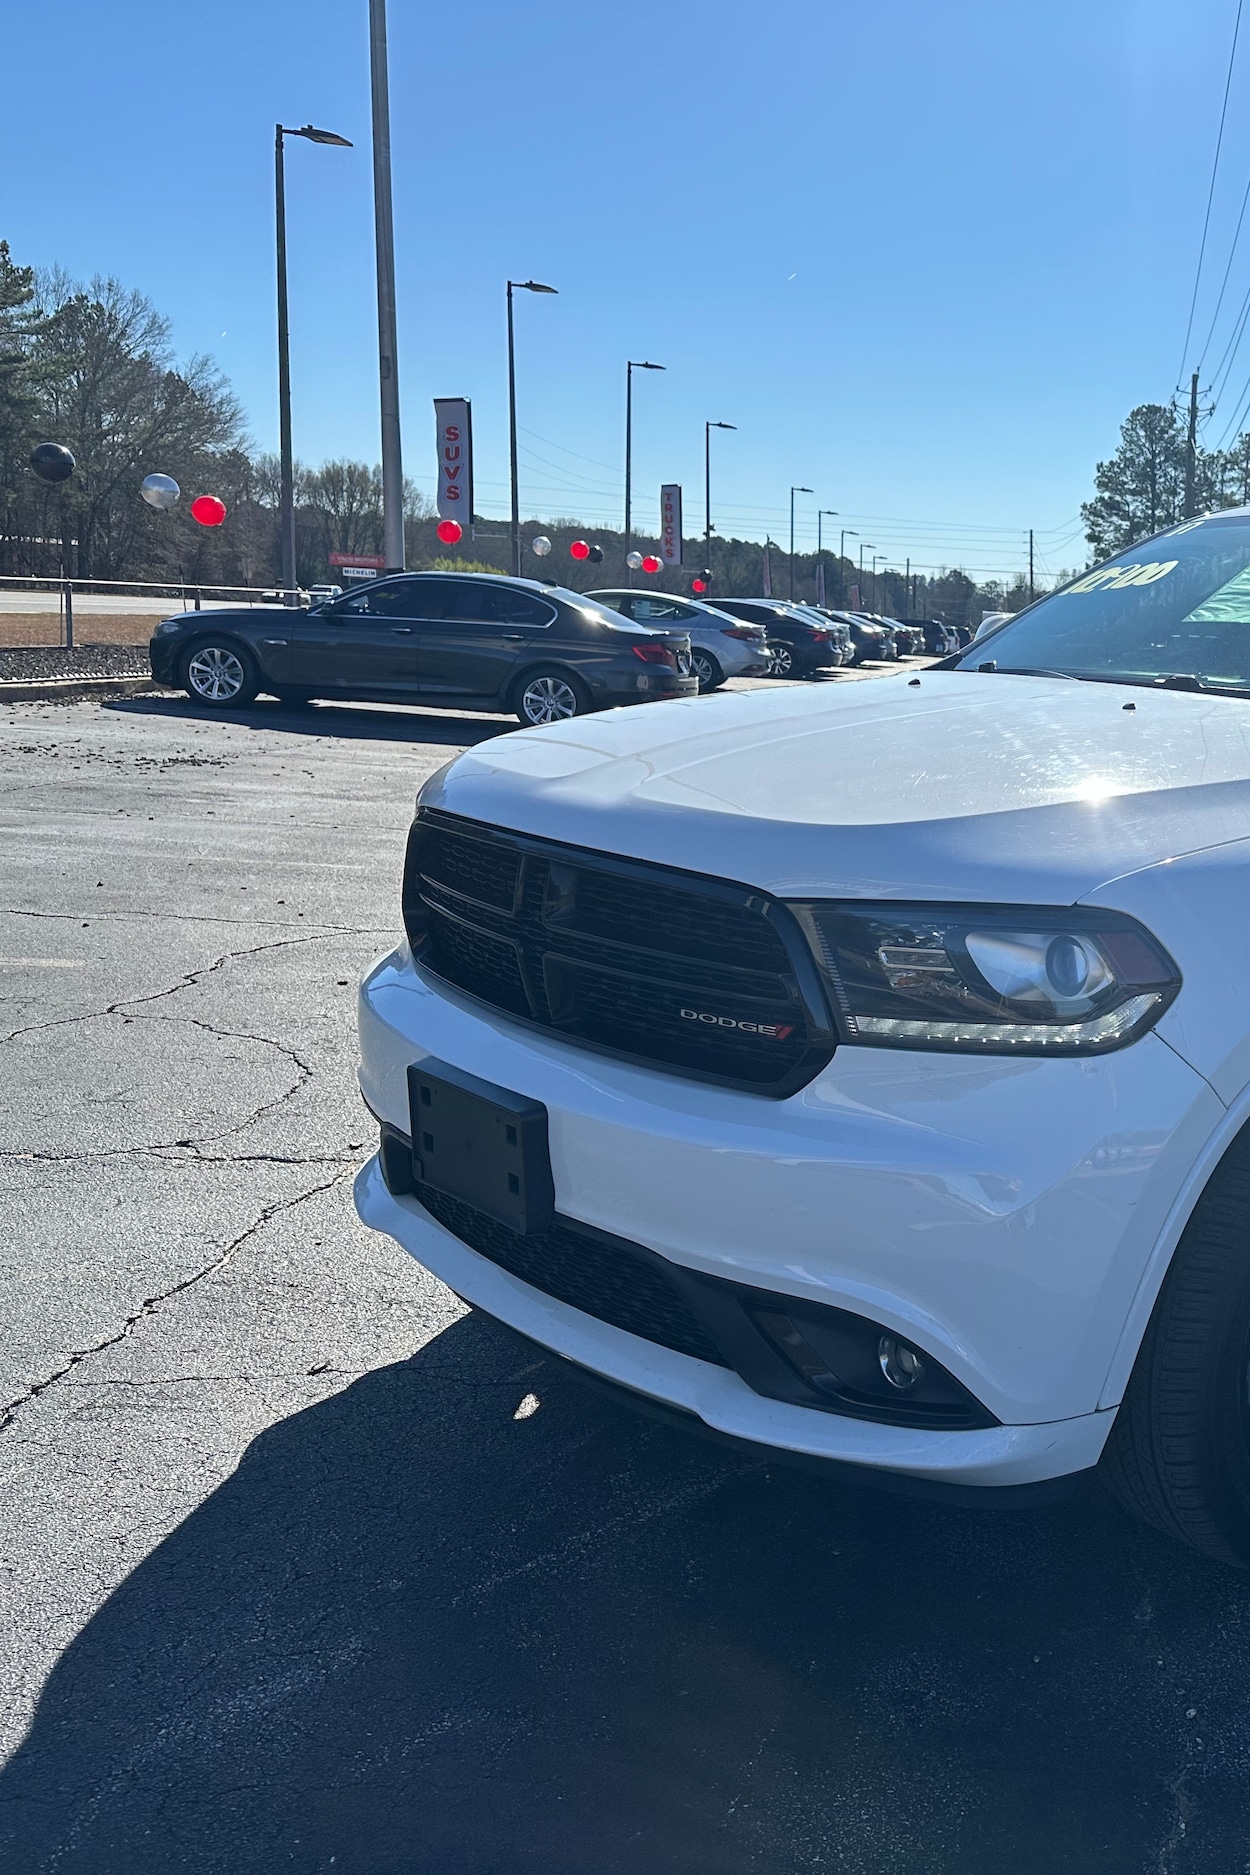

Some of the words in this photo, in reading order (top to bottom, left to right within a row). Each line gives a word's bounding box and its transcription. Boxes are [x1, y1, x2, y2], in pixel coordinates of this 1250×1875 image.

[444, 425, 461, 501] SUVS
[665, 493, 673, 558] TRUCKS
[680, 1008, 778, 1037] DODGE
